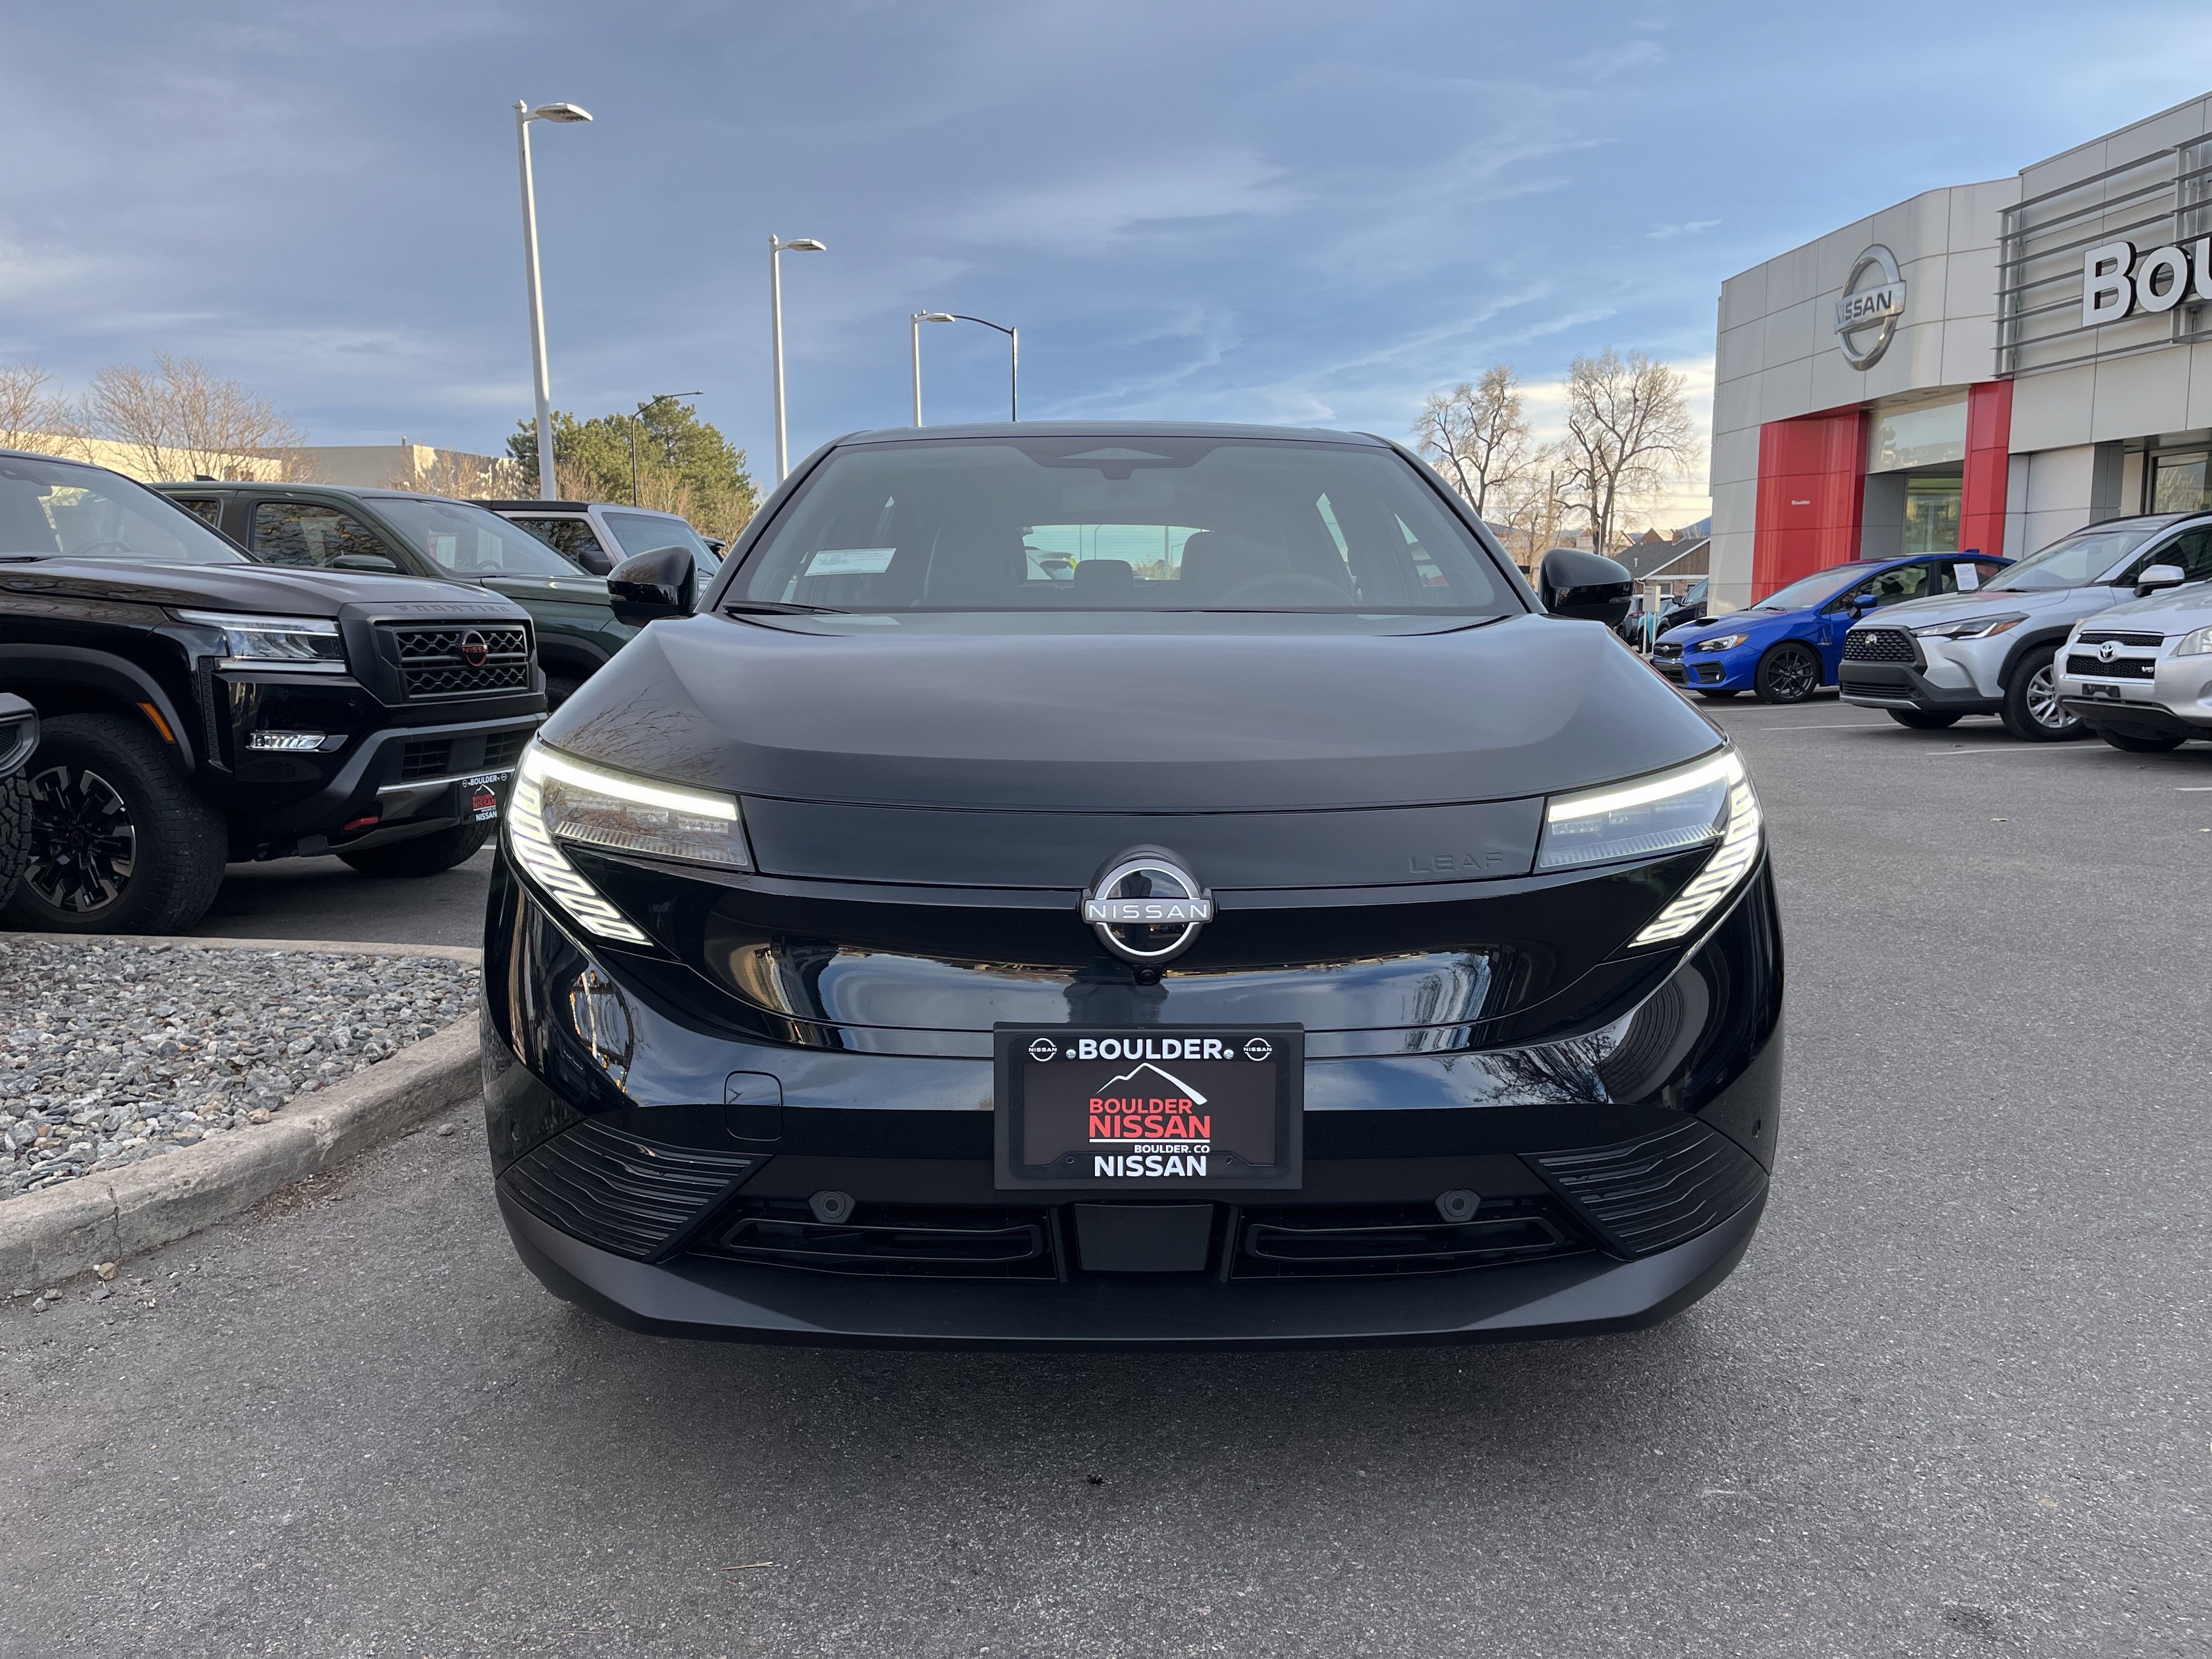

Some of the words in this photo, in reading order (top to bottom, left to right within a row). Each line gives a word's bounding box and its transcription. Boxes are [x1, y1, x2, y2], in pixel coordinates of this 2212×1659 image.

[470, 775, 497, 786] BOULDER
[473, 798, 496, 809] NISSAN
[476, 811, 497, 822] NISSAN
[1409, 852, 1502, 873] LEAF
[1089, 904, 1207, 919] NISSAN
[1079, 1039, 1222, 1059] BOULDER
[1090, 1098, 1193, 1114] BOULDER
[1089, 1115, 1210, 1138] NISSAN
[1134, 1144, 1191, 1154] BOULDER.
[1193, 1144, 1210, 1154] CO
[1094, 1155, 1206, 1177] NISSAN
